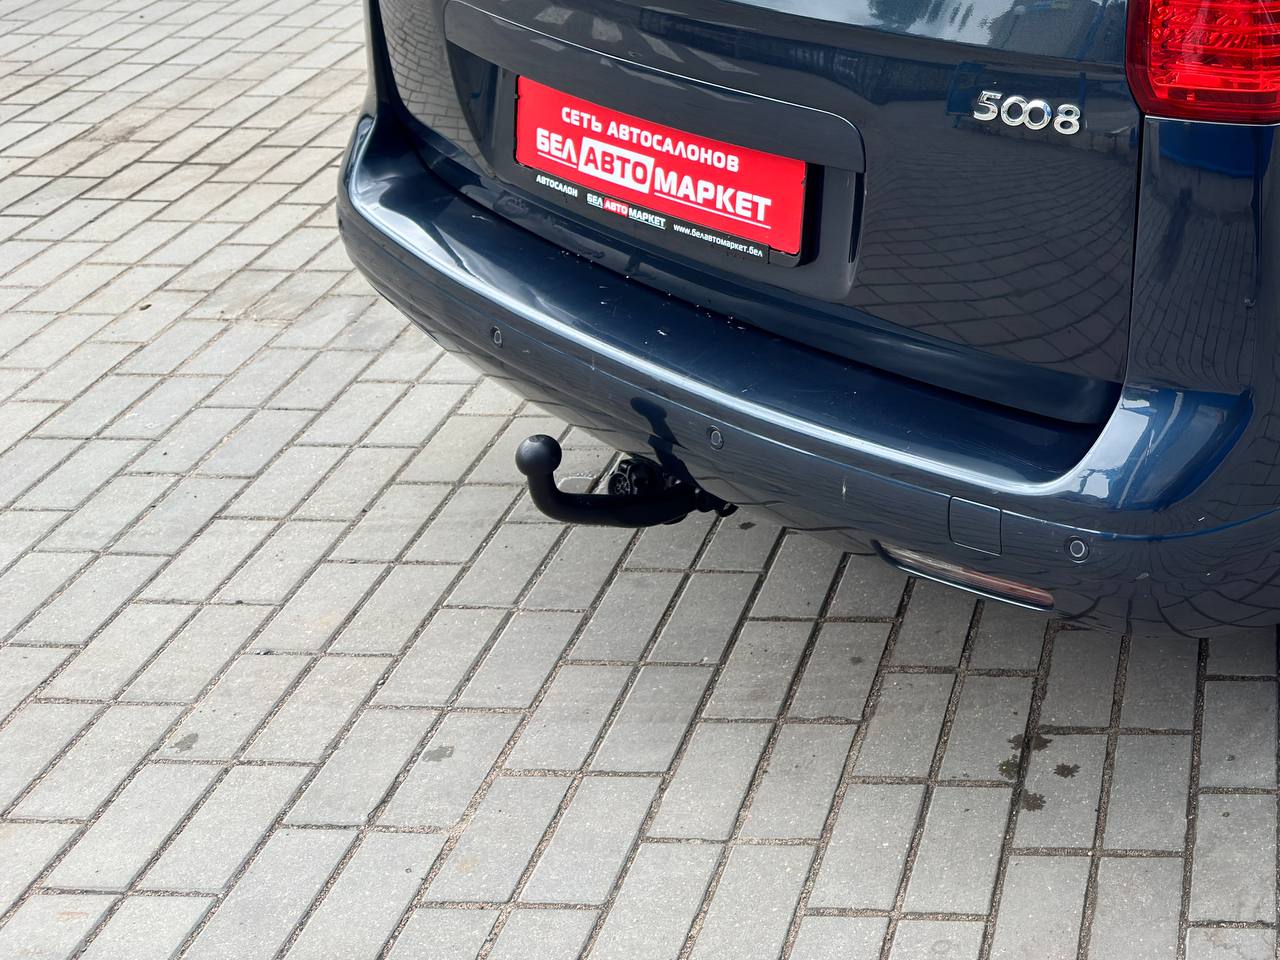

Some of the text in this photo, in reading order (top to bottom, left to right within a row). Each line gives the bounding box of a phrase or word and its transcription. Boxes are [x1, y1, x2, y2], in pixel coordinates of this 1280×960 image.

[561, 106, 740, 173] СЕТЬ АВТОСАЛОНОВ
[973, 90, 1081, 135] 5008
[535, 174, 578, 198] АВТОСАЛОН
[673, 223, 763, 258] www.белавтомаркет.бел
